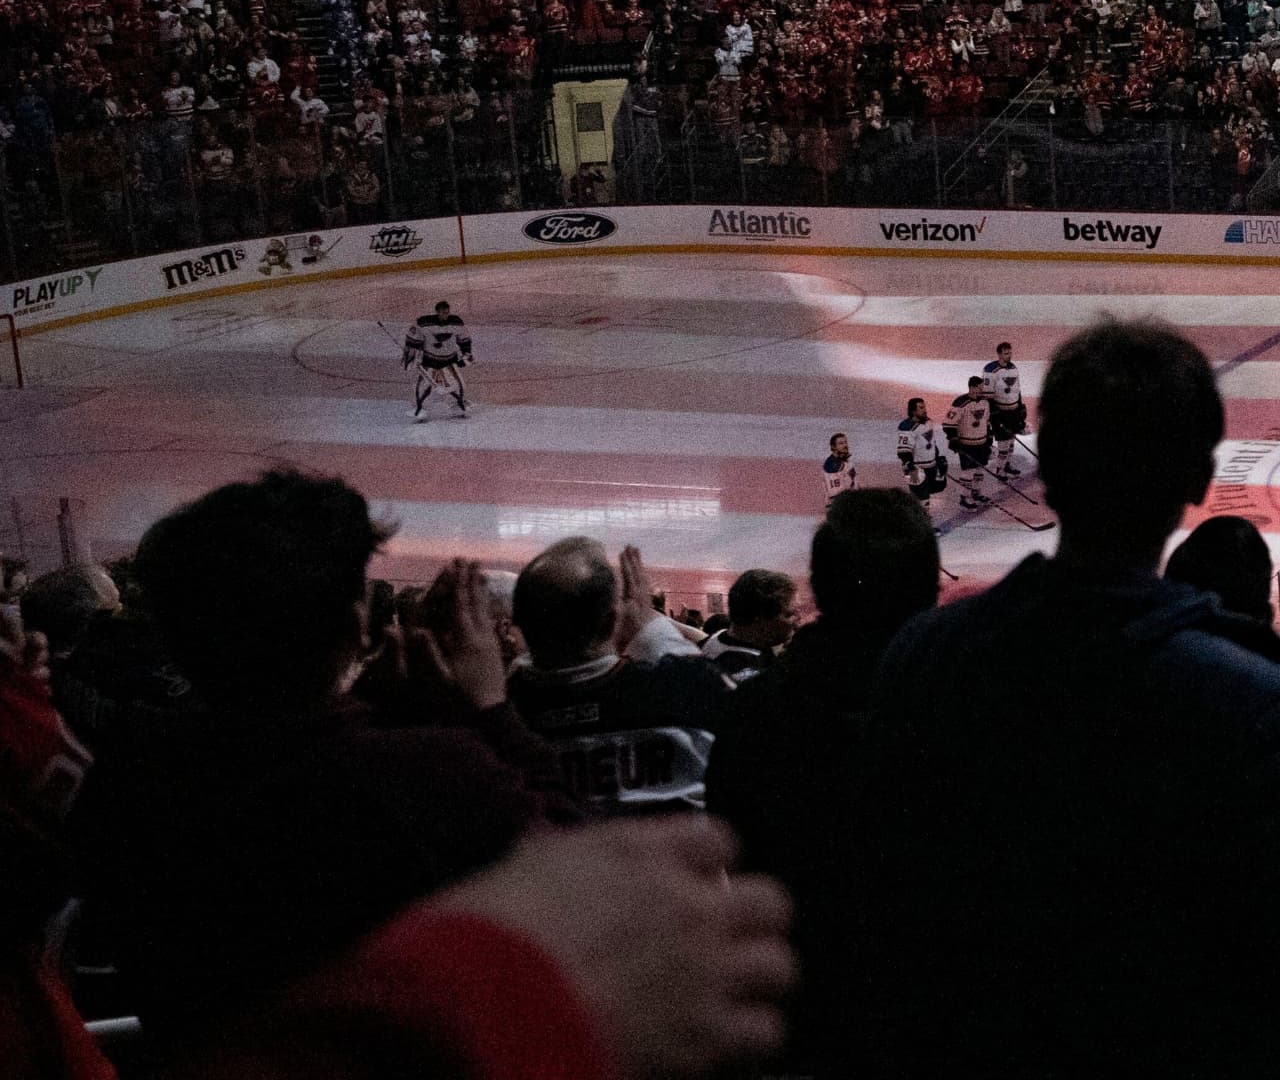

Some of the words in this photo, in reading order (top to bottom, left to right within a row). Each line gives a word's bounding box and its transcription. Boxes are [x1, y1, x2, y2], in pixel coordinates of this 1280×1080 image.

[539, 215, 601, 241] Ford
[708, 209, 811, 236] Atlantic
[880, 218, 976, 241] verizon
[1063, 218, 1162, 249] betway
[370, 229, 423, 251] NHL
